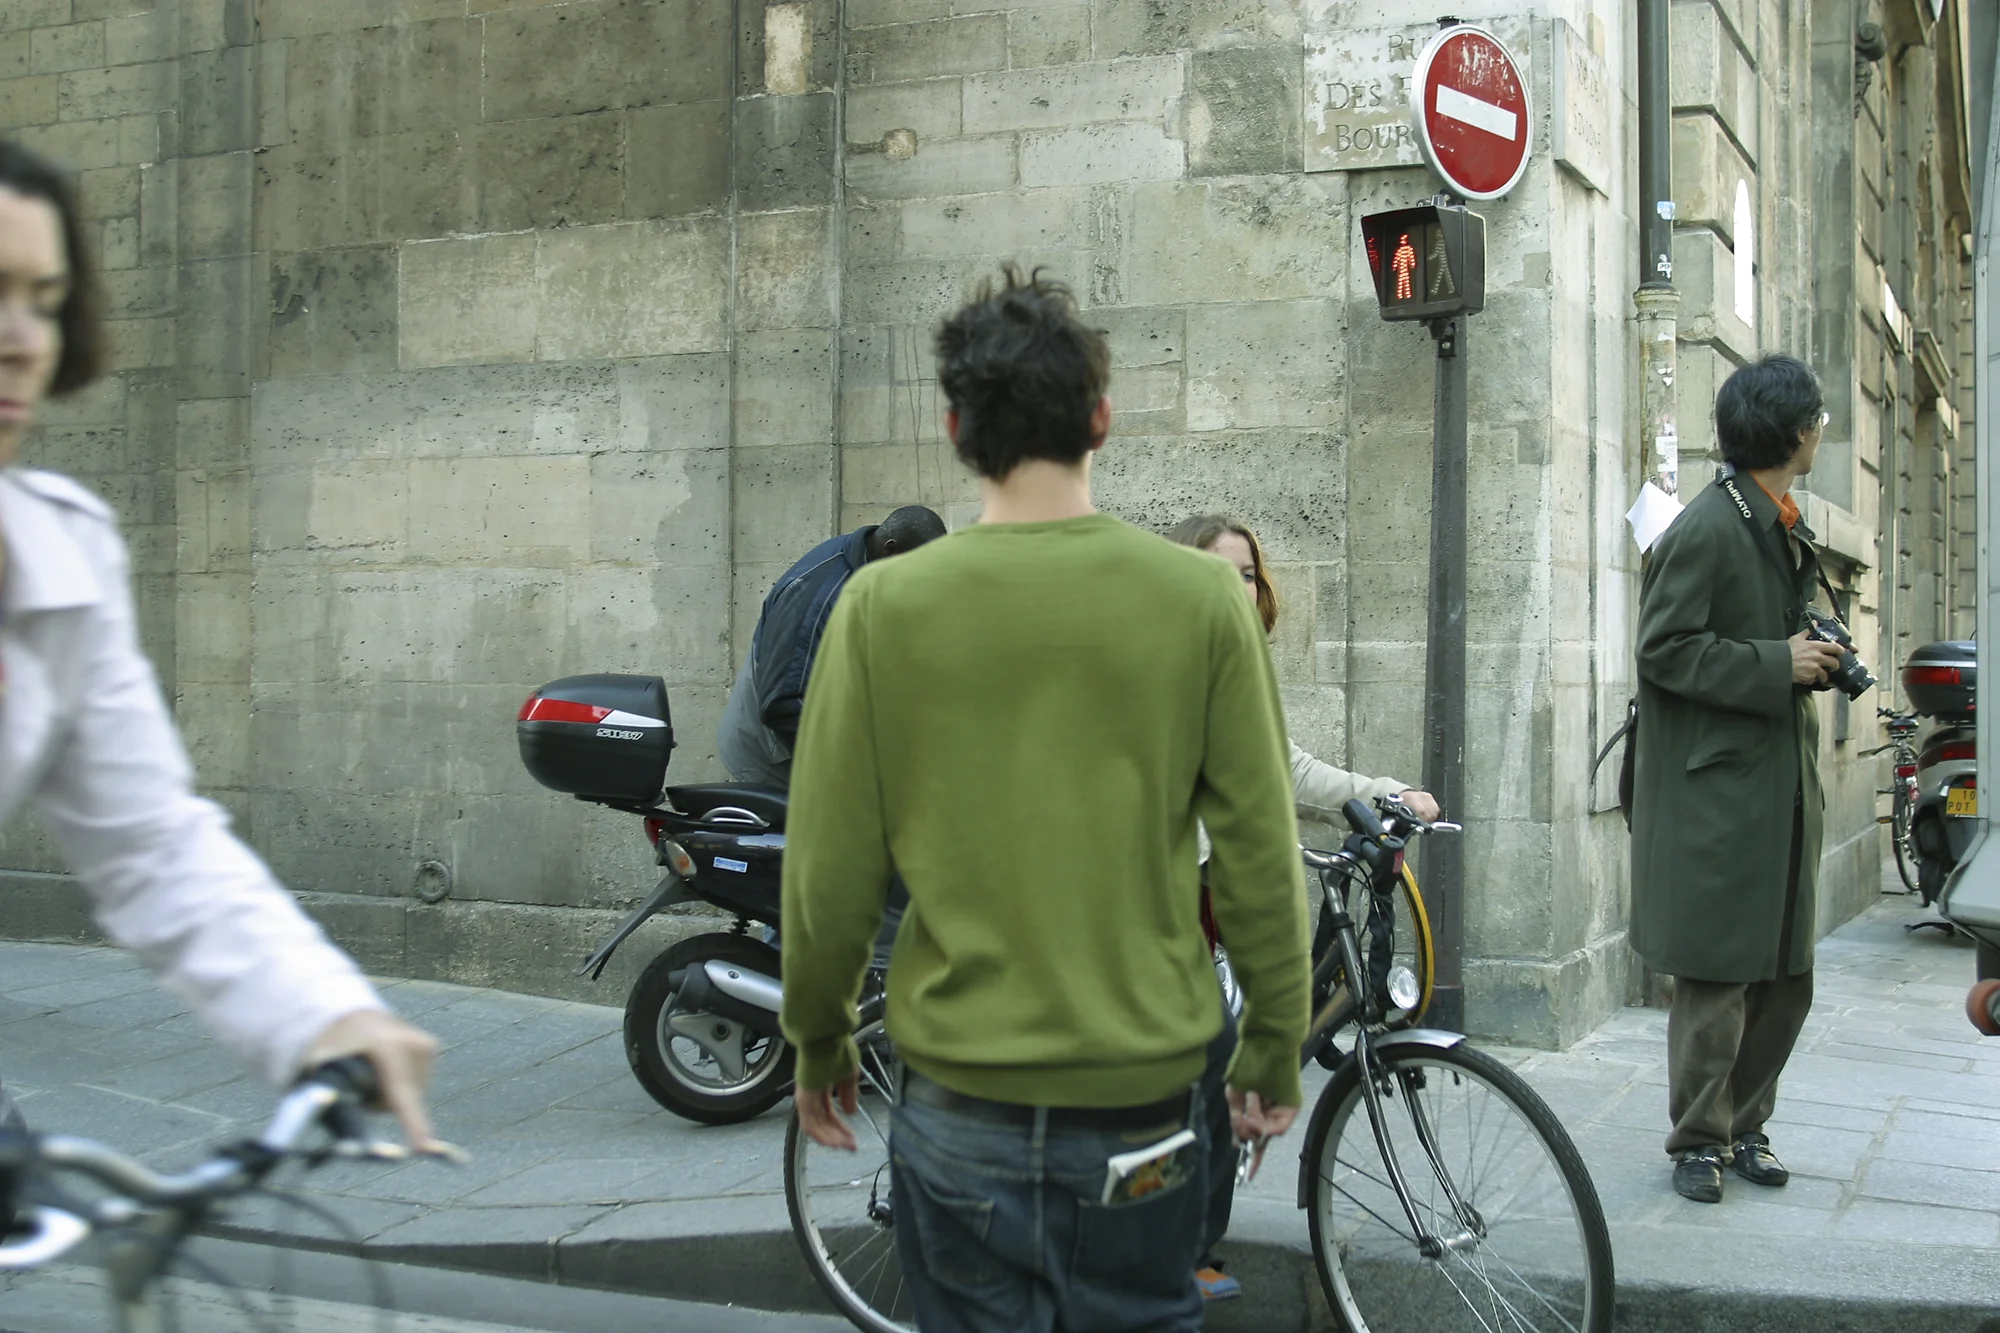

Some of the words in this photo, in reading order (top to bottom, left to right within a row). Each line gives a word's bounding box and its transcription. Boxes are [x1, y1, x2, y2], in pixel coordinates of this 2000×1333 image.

[1387, 34, 1431, 62] RU
[1325, 82, 1382, 111] DES
[1334, 124, 1412, 152] BOUR
[1725, 480, 1752, 519] OLYMPU
